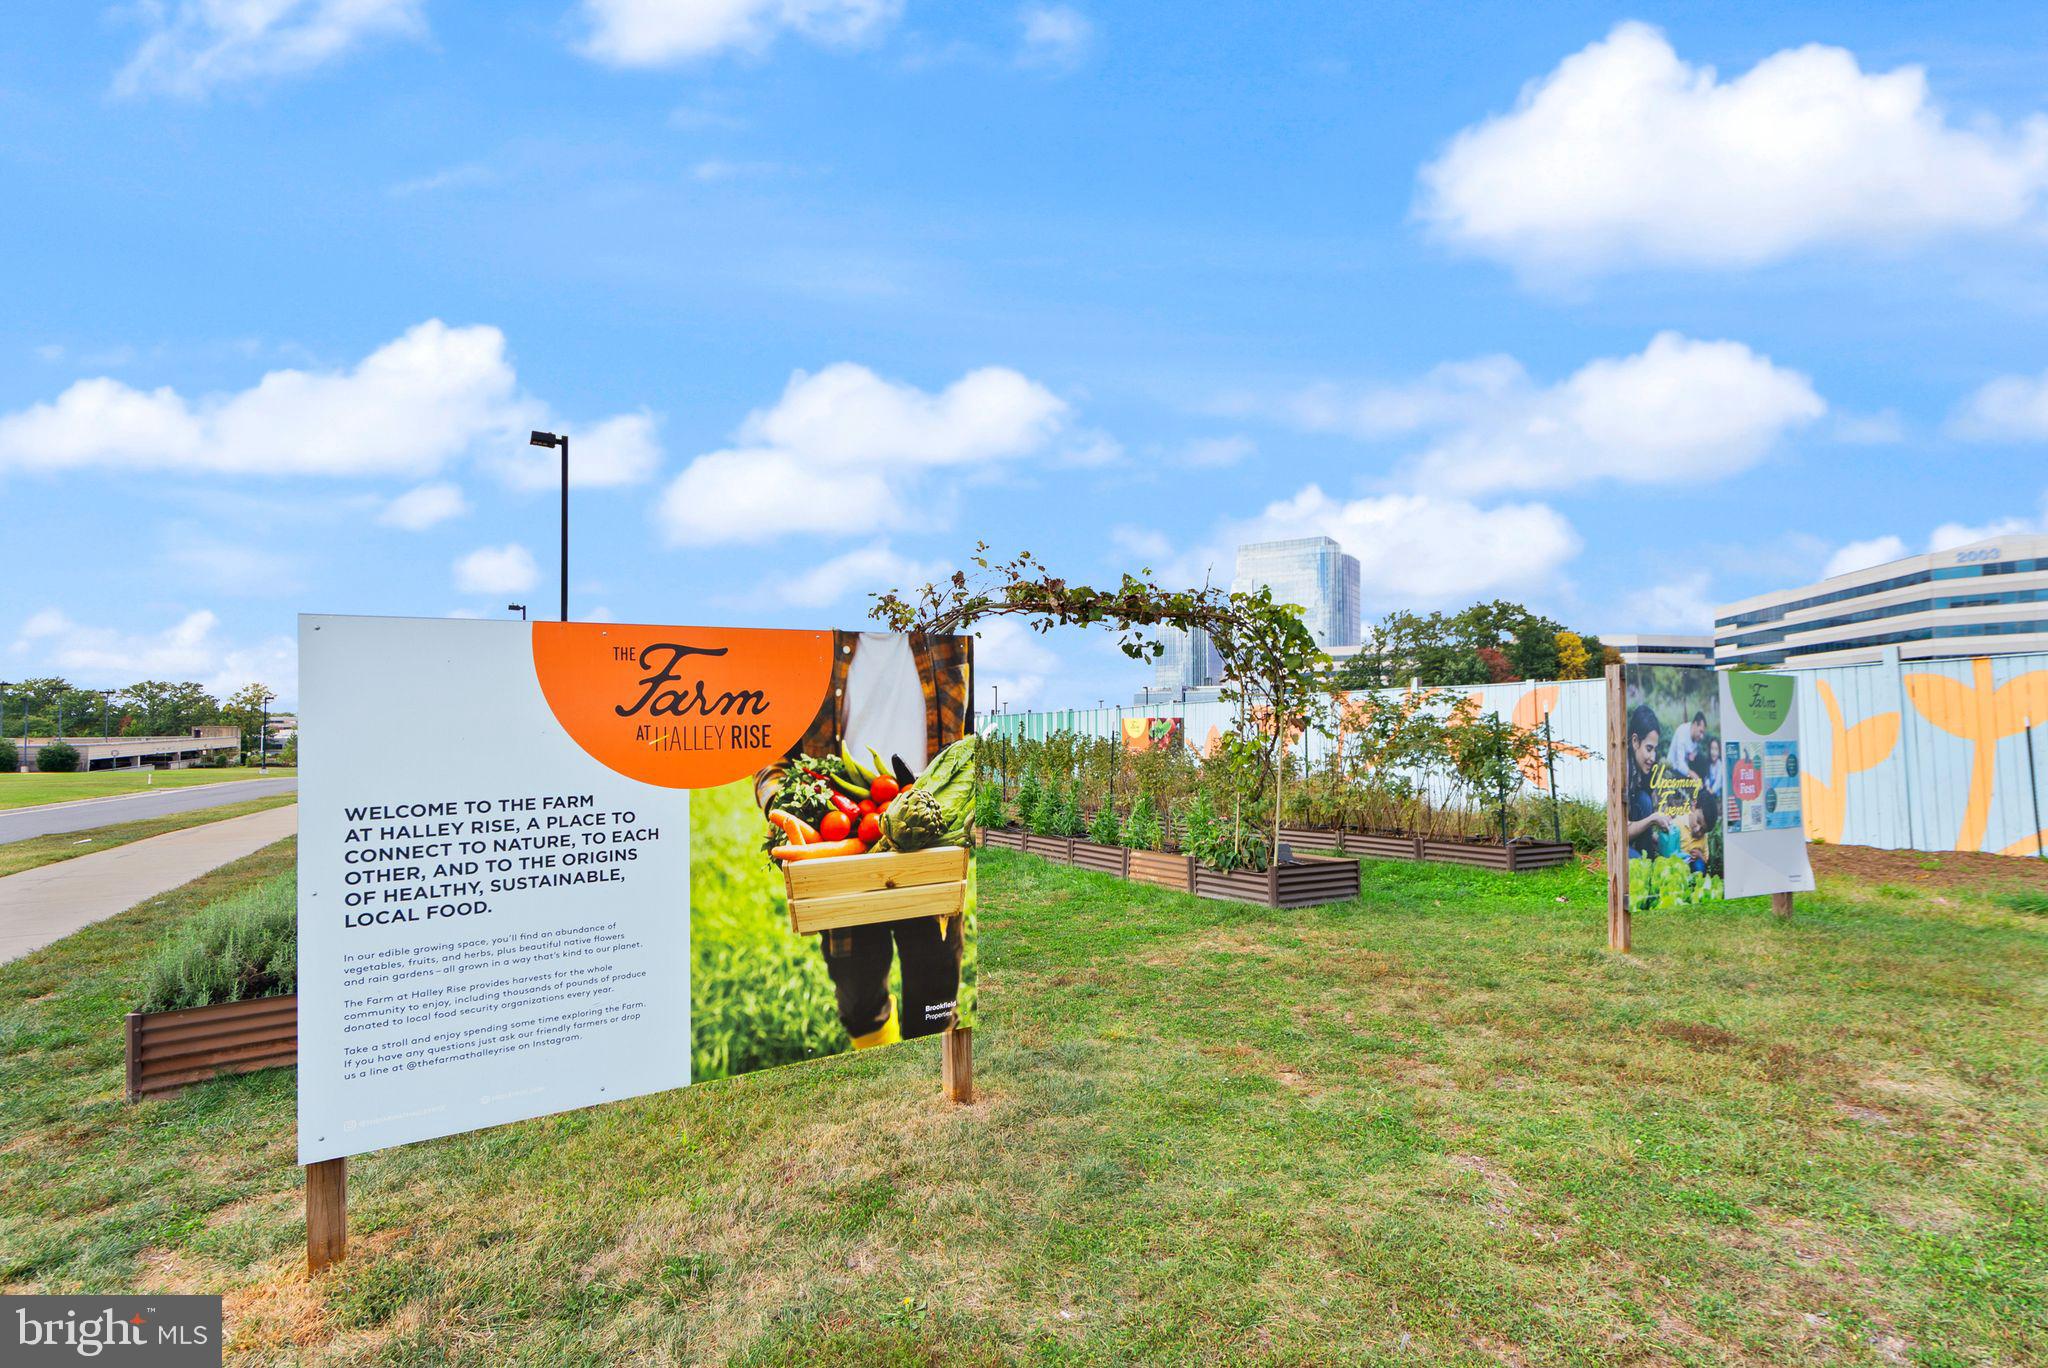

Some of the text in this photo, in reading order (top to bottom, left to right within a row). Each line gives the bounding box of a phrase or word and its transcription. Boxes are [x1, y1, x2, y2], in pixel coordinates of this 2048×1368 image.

[613, 646, 636, 661] THE
[614, 643, 770, 717] Farm
[636, 725, 772, 751] AT HALLEY RISE
[1650, 764, 1702, 799] Upcoming
[1740, 768, 1754, 780] Fall
[1740, 782, 1756, 794] Fest
[344, 795, 593, 822] WELCOME TO THE FARM
[1658, 790, 1692, 816] Events
[344, 811, 636, 843] AT HALLEY RISE, A PLACE TO
[344, 828, 659, 864] CONNECT TO NATURE, TO EACH
[344, 848, 637, 885] OTHER, AND TO THE ORIGINS
[344, 868, 625, 907] OF HEALTHY, SUSTAINABLE,
[345, 901, 492, 928] LOCAL FOOD.
[344, 934, 624, 975] vegetables, fruits, and herbs, plus beautiful native flowers
[378, 948, 410, 957] edible
[413, 944, 454, 955] growing
[458, 940, 488, 949] space,
[520, 932, 538, 940] find
[555, 926, 605, 936] abundance
[607, 922, 616, 930] of
[344, 977, 364, 986] and
[368, 975, 389, 983] rain
[392, 970, 434, 982] gardens
[443, 965, 455, 973] all
[458, 962, 488, 973] grown
[563, 949, 581, 957] kind
[613, 942, 643, 952] planet.
[344, 1000, 363, 1008] The
[367, 996, 393, 1005] Farm
[412, 989, 443, 998] Halley
[470, 980, 509, 992] provides
[513, 974, 551, 984] harvests
[587, 965, 612, 973] whole
[344, 1006, 406, 1020] community
[422, 1001, 451, 1009] enjoy,
[455, 993, 500, 1004] including
[503, 984, 551, 997] thousands
[554, 981, 563, 989] of
[566, 977, 598, 989] pounds
[612, 971, 646, 982] produce
[344, 1019, 389, 1032] donated
[407, 1013, 430, 1023] local
[434, 1009, 456, 1018] food
[460, 1005, 498, 1015] security
[501, 995, 564, 1009] organizations
[593, 987, 614, 996] year.
[925, 1000, 957, 1012] Brookfield
[925, 1011, 953, 1020] Properties
[344, 1046, 368, 1055] Take
[382, 1038, 408, 1049] stroll
[411, 1035, 431, 1045] and
[434, 1032, 461, 1041] enjoy
[464, 1024, 507, 1037] spending
[511, 1020, 535, 1028] some
[562, 1009, 602, 1020] exploring
[622, 1002, 647, 1010] Farm.
[344, 1059, 352, 1068] If
[355, 1058, 374, 1068] you
[378, 1053, 402, 1062] have
[427, 1041, 475, 1055] questions
[478, 1037, 496, 1048] just
[499, 1033, 515, 1042] ask
[536, 1024, 571, 1034] friendly
[573, 1019, 607, 1029] farmers
[621, 1013, 640, 1021] drop
[392, 1064, 403, 1072] at
[407, 1046, 515, 1070] @thefarmathalleyrise
[533, 1035, 583, 1047] Instagram.
